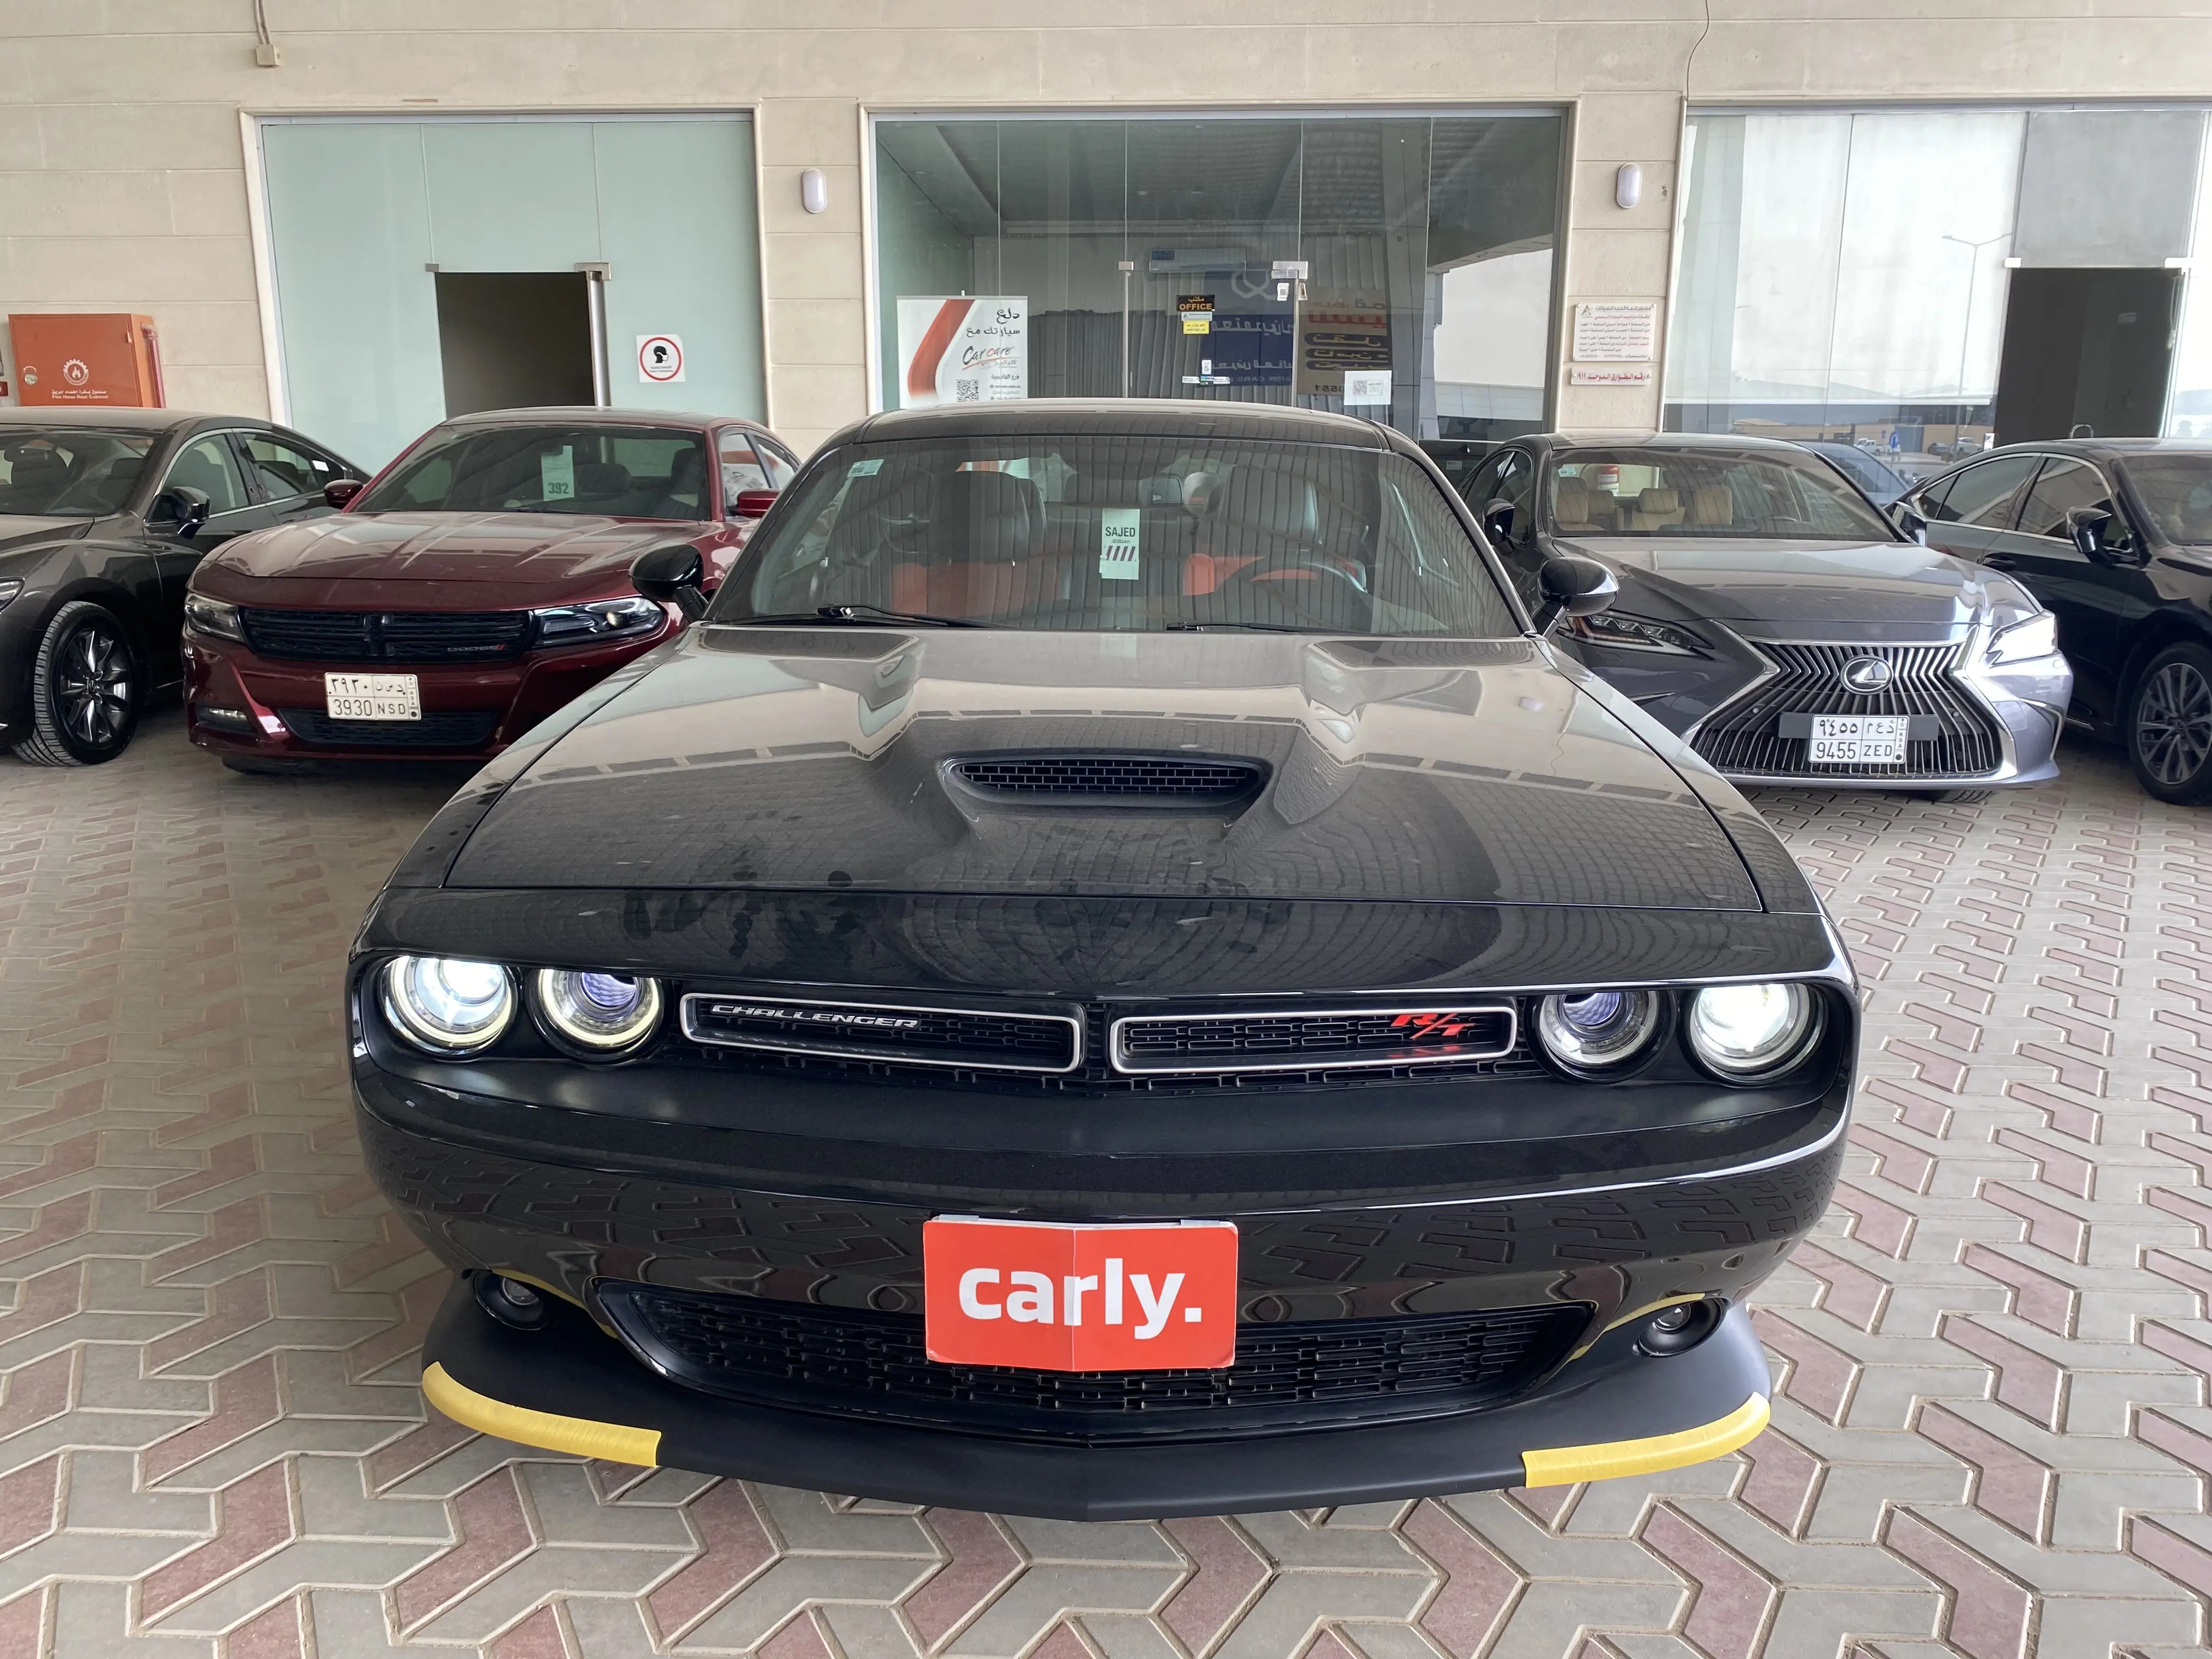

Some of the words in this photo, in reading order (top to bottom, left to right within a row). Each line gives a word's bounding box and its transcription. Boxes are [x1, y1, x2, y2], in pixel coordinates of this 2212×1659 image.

[996, 307, 1020, 324] دلع
[966, 328, 981, 338] مع
[983, 327, 1020, 337] سيارتك
[548, 482, 569, 494] 392
[1105, 526, 1136, 537] SAJED
[334, 699, 373, 716] 3930
[1816, 742, 1857, 759] 9455
[713, 1005, 918, 1028] CHALLENGER
[1390, 1012, 1477, 1041] R/T
[958, 1258, 1201, 1340] carly.
